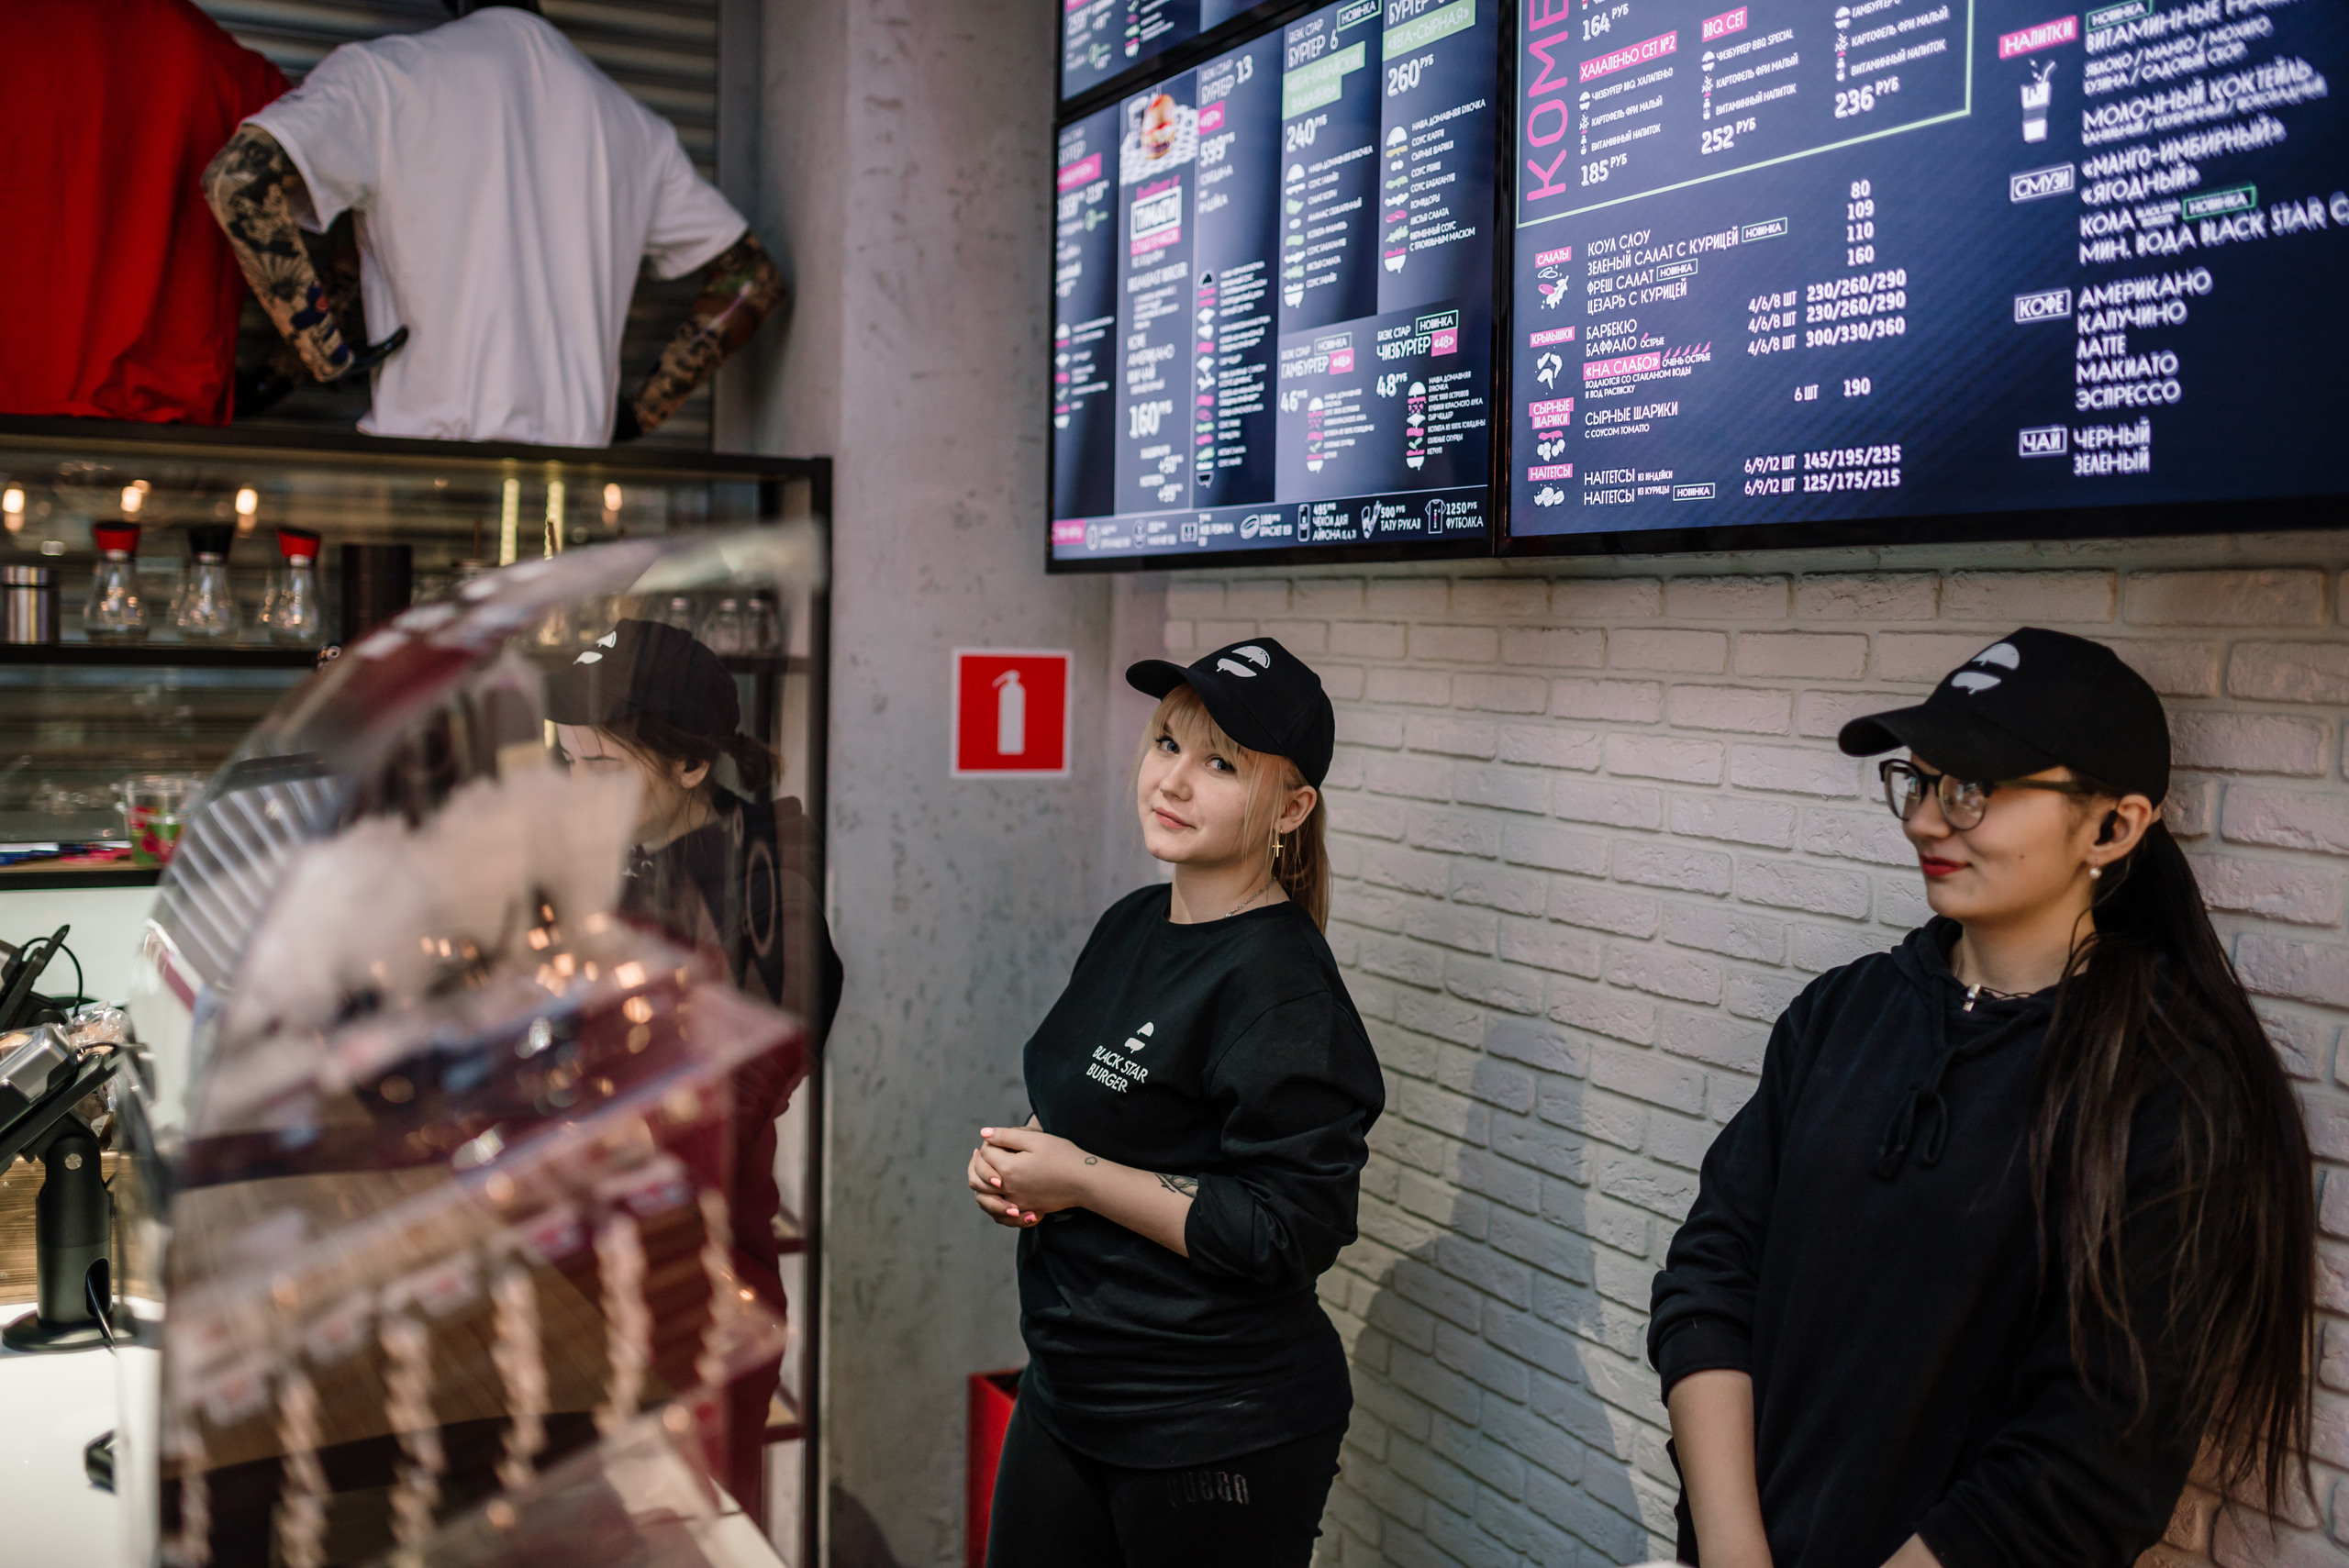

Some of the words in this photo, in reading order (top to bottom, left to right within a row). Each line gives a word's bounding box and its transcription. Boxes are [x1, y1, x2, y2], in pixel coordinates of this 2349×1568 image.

[1582, 12, 1610, 41] 164
[1612, 4, 1629, 19] РУБ
[1703, 18, 1724, 39] BBQ
[1726, 10, 1744, 29] СЕТ
[1852, 25, 1896, 47] КАРТОФЕЛЬ
[1898, 20, 1915, 32] ФРИ
[1916, 6, 1949, 27] МАЛЫЙ
[2086, 3, 2221, 54] ВИТАМИННЫЕ
[2091, 3, 2145, 28] НОВИНКА
[1330, 29, 1339, 50] 6
[1716, 43, 1751, 62] ЧИЗБУРГЕР
[1751, 38, 1766, 50] BBQ
[1767, 29, 1794, 47] SPECIAL
[2004, 20, 2073, 53] НАПИТКИ
[1236, 55, 1252, 83] 13
[1580, 48, 1639, 80] ХАЛАПЕНЬО
[1642, 41, 1657, 58] СЕТ
[1660, 35, 1675, 52] №2
[1716, 69, 1753, 89] КАРТОФЕЛЬ
[1753, 65, 1769, 79] ФРИ
[1770, 53, 1798, 74] МАЛЫЙ
[1851, 50, 1905, 77] ВИТАМИННЫЙ
[1907, 39, 1947, 62] НАПИТОК
[1387, 59, 1420, 97] 260
[1419, 53, 1434, 70] РУБ
[1591, 83, 1623, 100] ЧИЗБУРГЕР
[1715, 95, 1762, 116] ВИТАМИННЫЙ
[1764, 83, 1797, 103] НАПИТОК
[1834, 85, 1875, 119] 236
[1875, 77, 1899, 96] РУБ
[2082, 75, 2206, 130] МОЛОЧНЫЙ
[2209, 55, 2313, 102] КОКТЕЙЛЬ
[1591, 108, 1625, 128] КАРТОФЕЛЬ
[1625, 102, 1639, 116] ФРИ
[1639, 95, 1663, 113] МАЛЫЙ
[1286, 118, 1316, 153] 240
[1590, 129, 1631, 152] ВИТАМИННЫЙ
[1633, 124, 1661, 142] НАПИТОК
[1701, 126, 1734, 155] 252
[1736, 117, 1756, 134] РУБ
[2081, 113, 2287, 179] «МАНГО-ИМБИРНЫЙ»
[1581, 160, 1609, 185] 185
[1610, 153, 1628, 168] РУБ
[1850, 181, 1871, 199] 80
[2013, 171, 2069, 199] СМУЗИ
[2080, 163, 2200, 206] «ЯГОДНЫЙ»
[1846, 202, 1875, 221] 109
[2079, 206, 2135, 239] КОЛА
[1587, 238, 1617, 257] КОУЛ
[1619, 230, 1651, 251] СЛОУ
[1846, 223, 1875, 242] 110
[2079, 234, 2132, 266] МИН.
[2135, 223, 2198, 258] ВОДА
[2199, 207, 2267, 248] BLACK
[2270, 195, 2327, 237] STAR
[1536, 249, 1570, 267] САЛАТЫ
[1586, 251, 1631, 277] ЗЕЛЕНЫЙ
[1634, 244, 1674, 267] САЛАТ
[1675, 240, 1687, 257] С
[1688, 226, 1739, 254] КУРИЦЕЙ
[1745, 221, 1782, 239] НОВИНКА
[1846, 245, 1875, 266] 160
[1586, 276, 1614, 295] ФРЕШ
[1615, 270, 1653, 289] САЛАТ
[1660, 263, 1693, 277] НОВИНКА
[1748, 294, 1782, 314] 4/6/8
[1782, 290, 1798, 307] ШТ
[1806, 268, 1907, 304] 230/260/290
[2077, 266, 2213, 309] АМЕРИКАНО
[1586, 293, 1627, 317] ЦЕЗАРЬ
[1640, 278, 1687, 304] КУРИЦЕЙ
[2019, 295, 2065, 319] КОФЕ
[1419, 316, 1453, 331] НОВИНКА
[1748, 314, 1782, 334] 4/6/8
[1782, 311, 1798, 328] ШТ
[1805, 291, 1907, 324] 230/260/290
[2076, 298, 2188, 335] КАПУЧИНО
[1531, 328, 1573, 344] КРЫЛЫШКИ
[1586, 319, 1638, 340] БАРБЕКЮ
[1747, 336, 1782, 356] 4/6/8
[1782, 333, 1797, 350] ШТ
[1805, 316, 1906, 349] 300/330/360
[1376, 336, 1431, 361] ЧИЗБУРГЕР
[1433, 334, 1454, 350] «48»
[1586, 337, 1638, 358] БАФФАЛО
[1640, 336, 1664, 349] ОСТРЫЕ
[2076, 333, 2127, 360] ЛАТТЕ
[1585, 362, 1611, 379] «НА
[1613, 356, 1659, 375] СЛАБО»
[1662, 356, 1684, 368] ОЧЕНЬ
[1685, 351, 1711, 364] ОСТРЫЕ
[1585, 377, 1620, 390] ПОДАЮТСЯ
[1621, 376, 1631, 385] СО
[1632, 371, 1670, 384] СТАКАНОМ
[1672, 366, 1691, 377] ВОДЫ
[2076, 350, 2178, 384] МАКИАТО
[1376, 373, 1397, 397] 48
[1397, 372, 1408, 383] РУБ
[1604, 384, 1635, 397] РАСПИСКУ
[1794, 387, 1803, 402] 6
[1805, 384, 1819, 401] ШТ
[1843, 378, 1871, 397] 190
[2075, 377, 2182, 411] ЭСПРЕССО
[1281, 391, 1299, 412] 46
[1532, 399, 1571, 415] СЫРНЫЕ
[1585, 407, 1631, 426] СЫРНЫЕ
[1633, 402, 1678, 420] ШАРИКИ
[1130, 401, 1160, 439] 160
[1533, 413, 1569, 428] ШАРИКИ
[1591, 426, 1620, 438] СОУСОМ
[1620, 423, 1650, 435] ТОМАТО
[2073, 415, 2151, 450] ЧЕРНЫЙ
[2021, 425, 2063, 452] ЧАЙ
[1530, 464, 1572, 480] НАГГЕТСЫ
[1743, 457, 1779, 474] 6/9/12
[1781, 454, 1795, 471] ШТ
[1803, 445, 1901, 470] 145/195/235
[2073, 447, 2150, 476] ЗЕЛЕНЫЙ
[1584, 468, 1635, 485] НАГГЕТСЫ
[1645, 469, 1673, 481] ИНДЕЙКИ
[1743, 477, 1779, 496] 6/9/12
[1781, 476, 1795, 494] ШТ
[1803, 469, 1900, 494] 125/175/215
[1446, 502, 1466, 515] 1250
[1467, 501, 1477, 509] РУБ
[1584, 488, 1634, 506] НАГГЕТСЫ
[1645, 484, 1670, 496] КУРИЦЫ
[1677, 485, 1709, 497] НОВИНКА
[1380, 506, 1396, 518] 500
[1396, 505, 1406, 513] РУБ
[1381, 519, 1397, 531] ТАТУ
[1397, 517, 1421, 530] РУКАВ
[1446, 516, 1483, 528] ФУТБОЛКА
[1086, 1062, 1129, 1093] BURGER
[1092, 1045, 1124, 1070] BLACK
[1120, 1061, 1149, 1083] STAR
